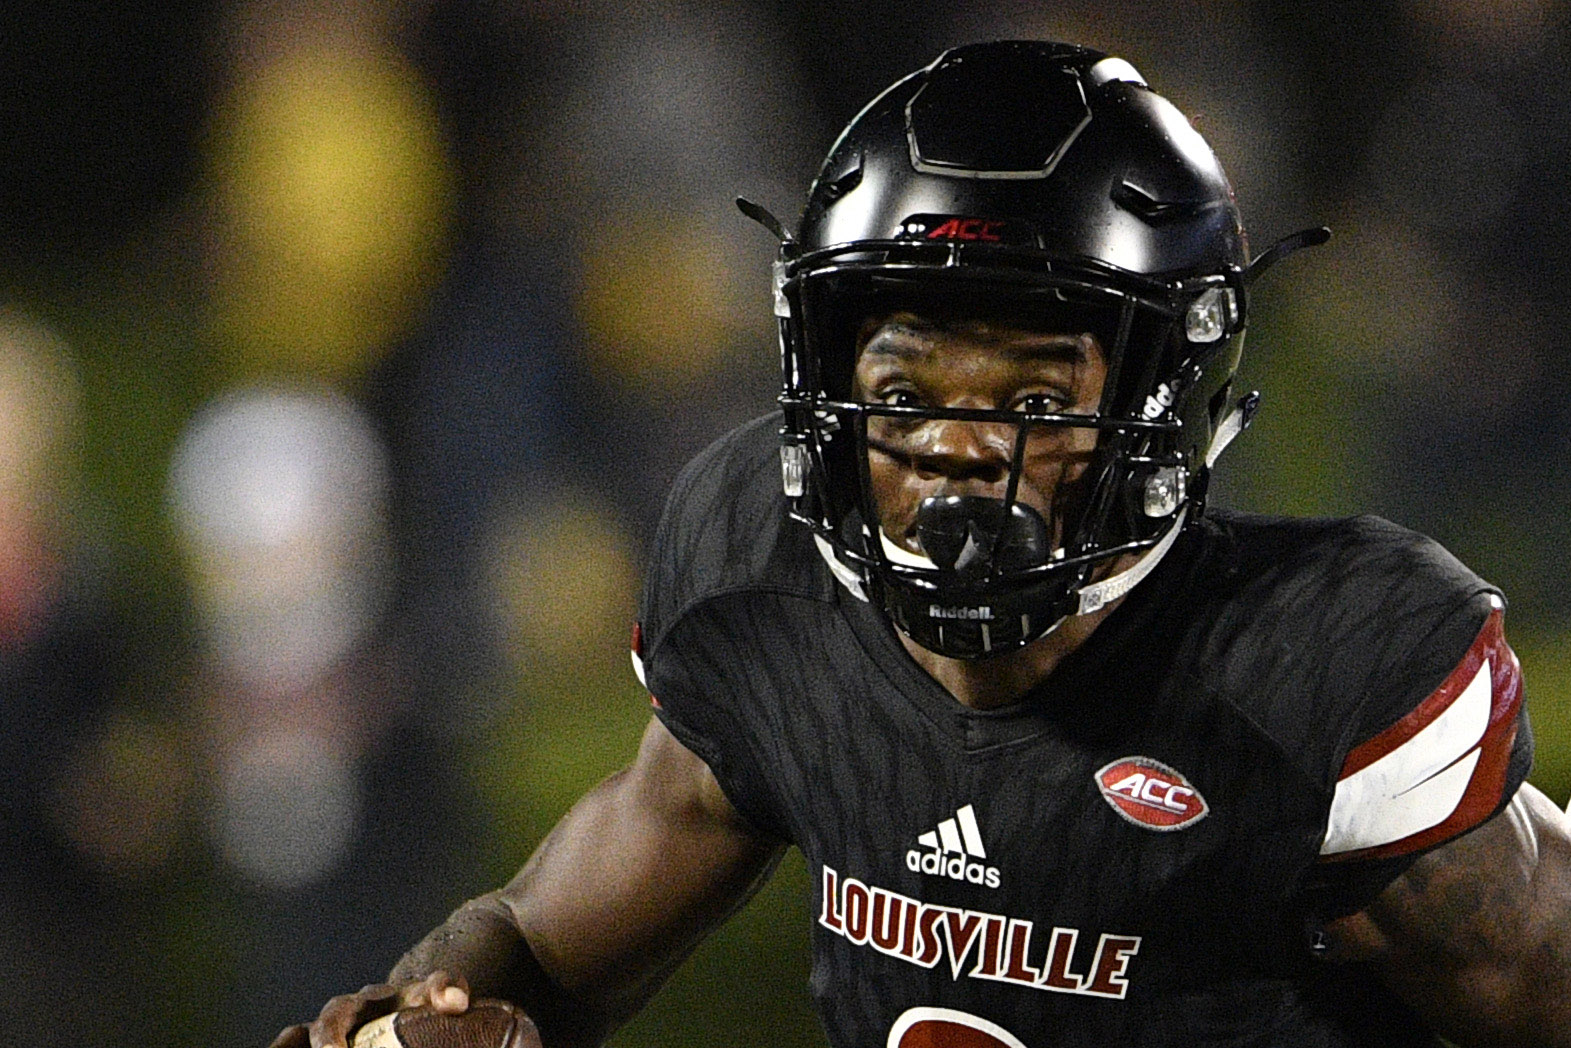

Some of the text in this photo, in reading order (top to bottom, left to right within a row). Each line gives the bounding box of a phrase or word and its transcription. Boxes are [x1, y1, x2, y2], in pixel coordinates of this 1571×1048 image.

[926, 218, 1004, 241] ACC
[1110, 773, 1194, 811] ACC
[906, 848, 1000, 888] adidas
[819, 865, 1142, 1000] LOUISVILLE
